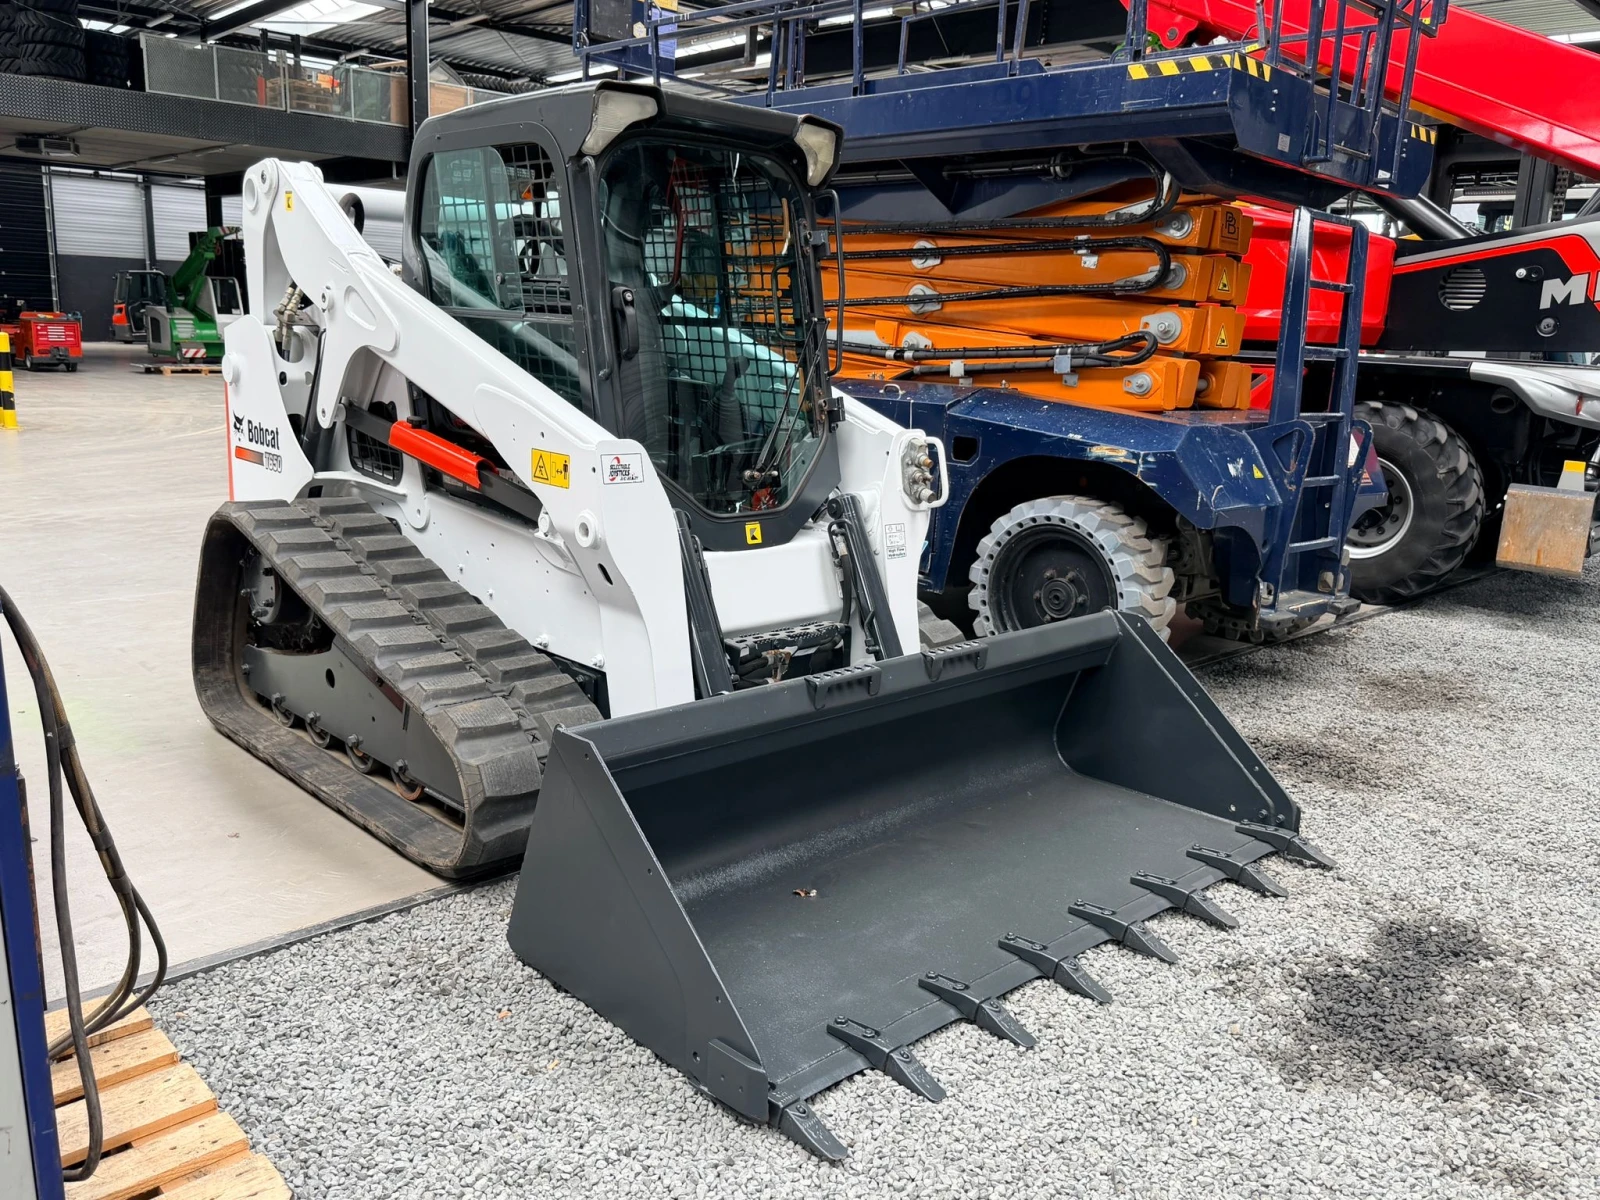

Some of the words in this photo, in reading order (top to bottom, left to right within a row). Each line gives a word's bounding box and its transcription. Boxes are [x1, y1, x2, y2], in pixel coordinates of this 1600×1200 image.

[1539, 272, 1600, 310] M
[247, 419, 280, 450] Bobcat
[264, 451, 282, 473] T650
